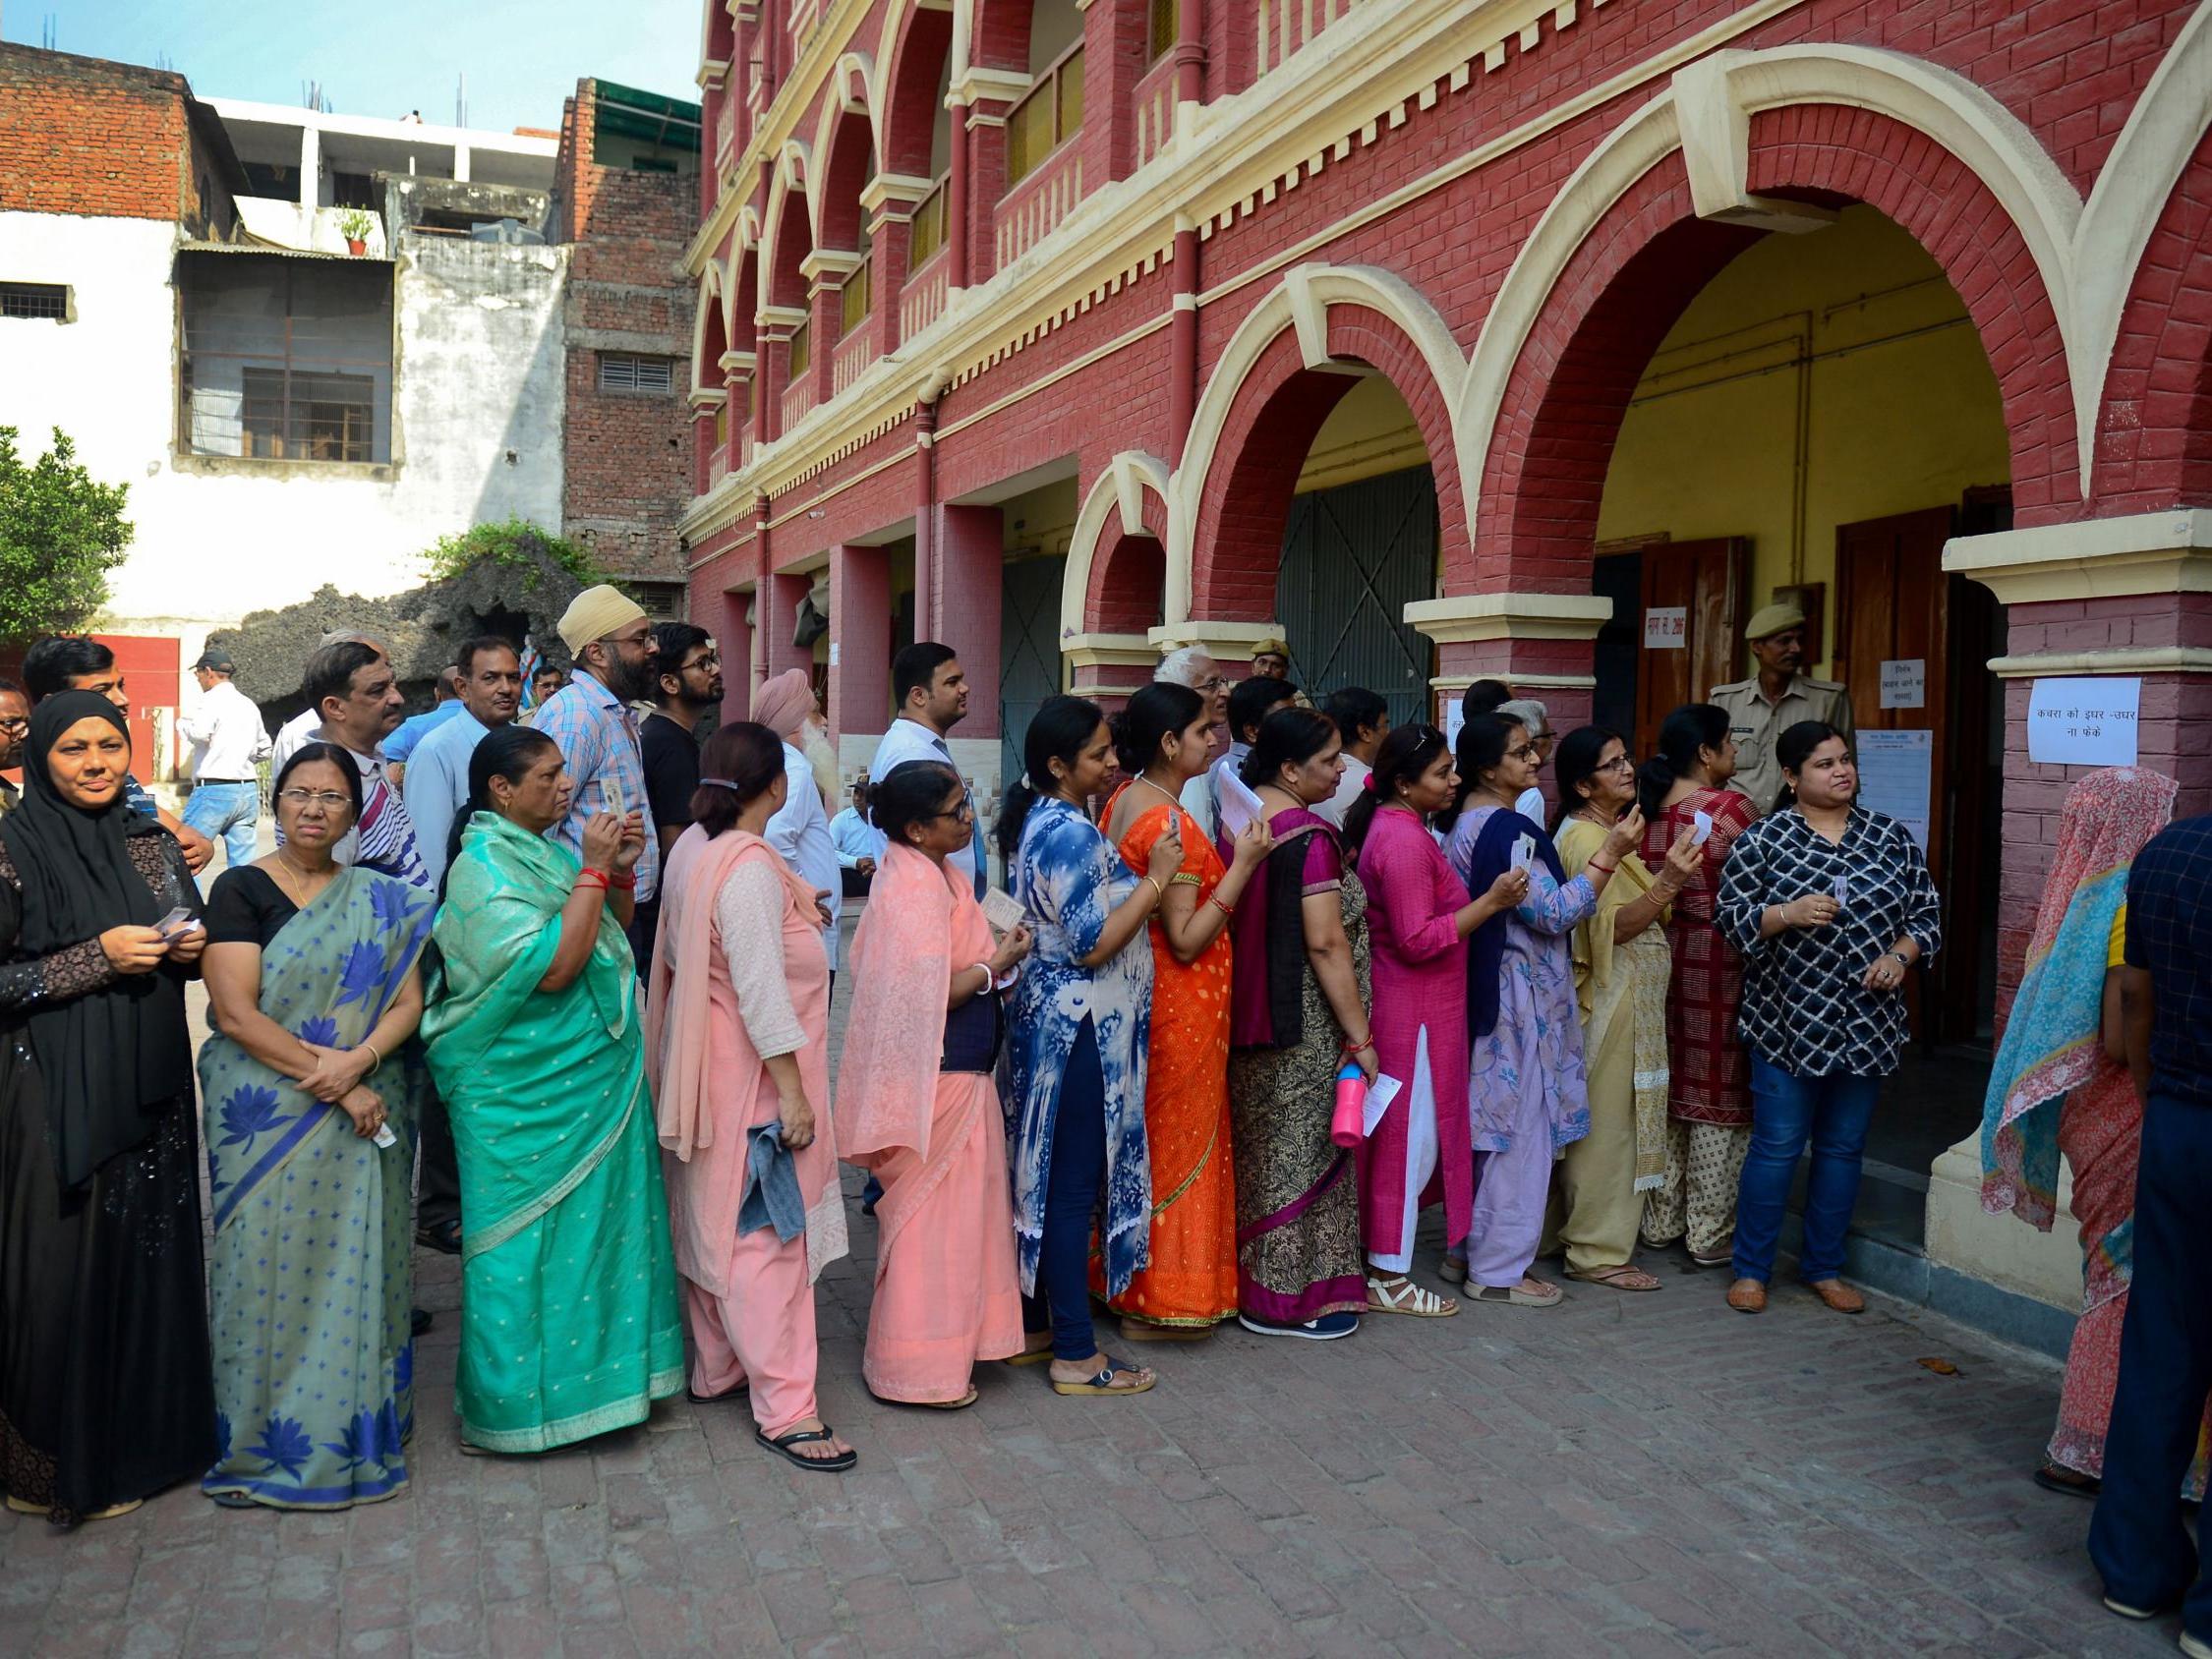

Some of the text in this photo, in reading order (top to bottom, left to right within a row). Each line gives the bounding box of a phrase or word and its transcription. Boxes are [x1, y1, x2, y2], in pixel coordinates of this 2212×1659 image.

[2037, 709, 2062, 719] कचरा
[2067, 708, 2078, 719] को
[2067, 728, 2077, 737] ना
